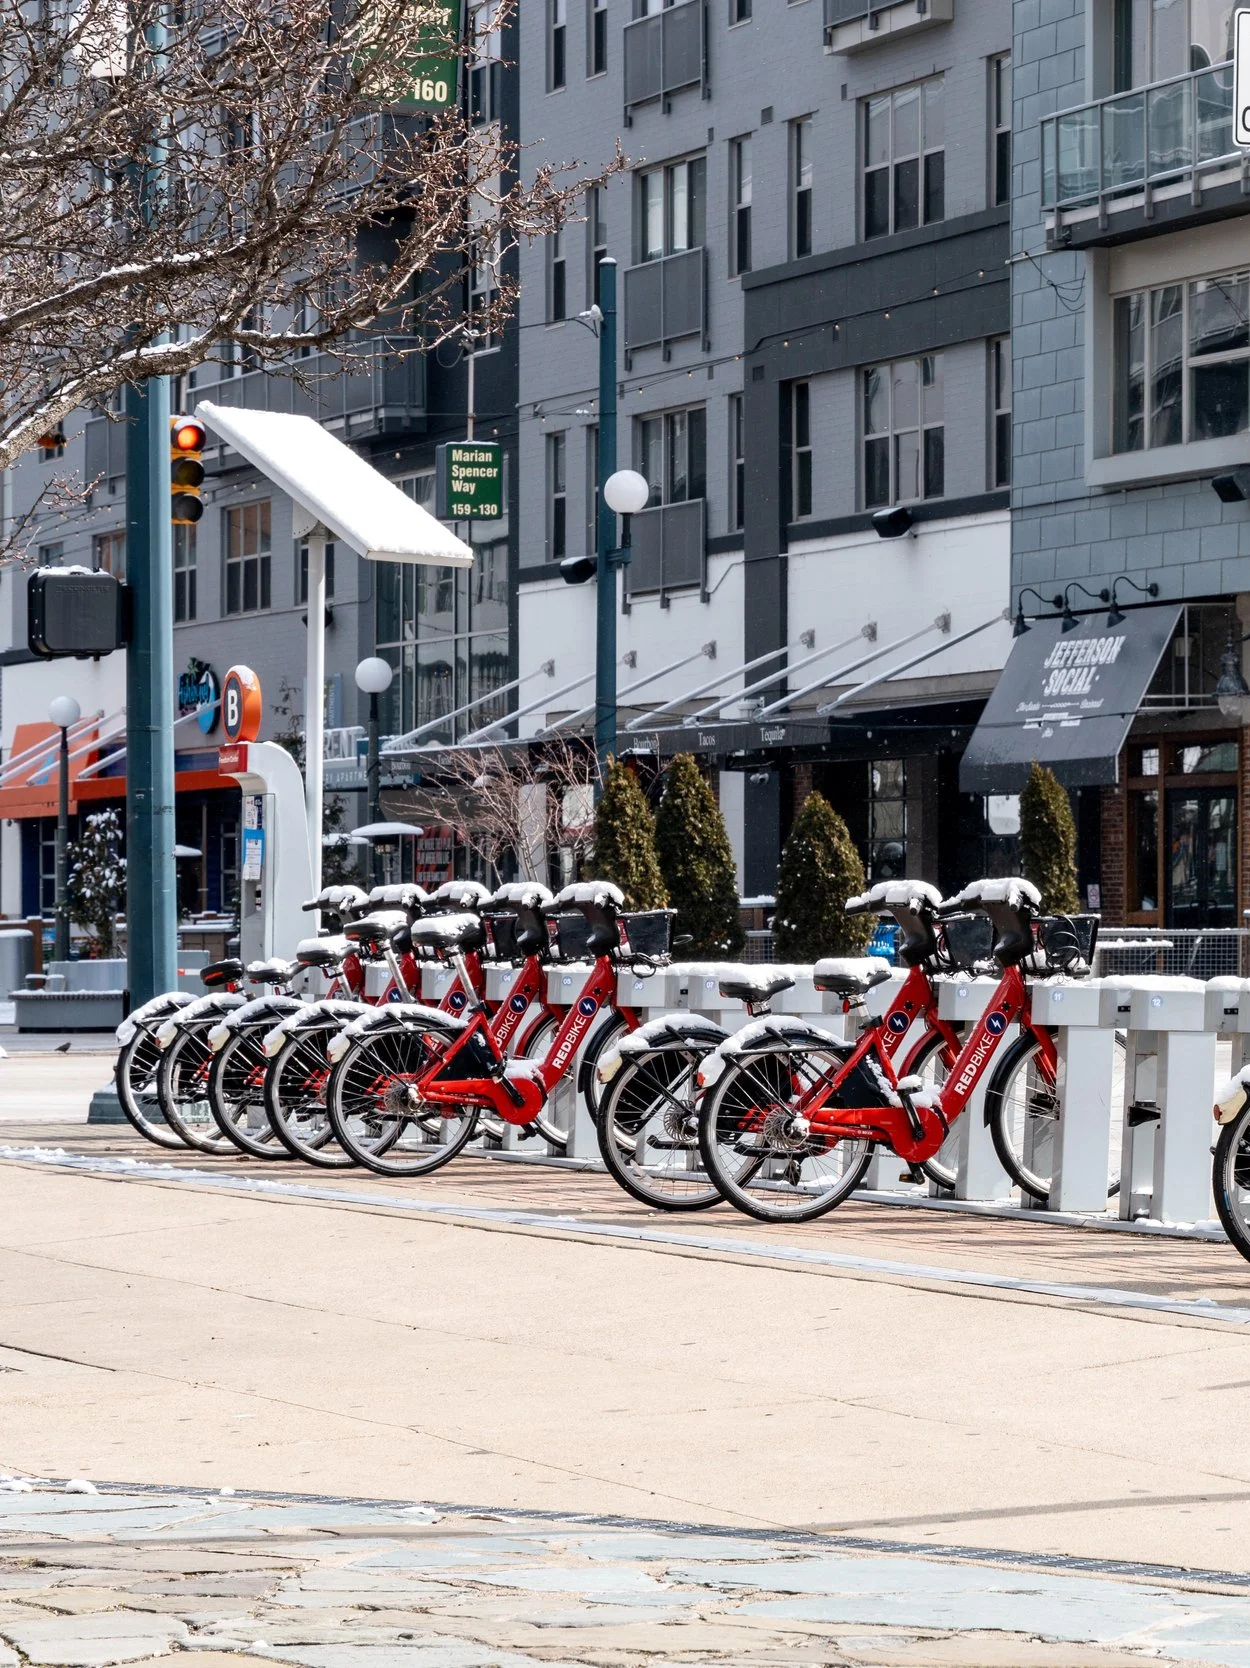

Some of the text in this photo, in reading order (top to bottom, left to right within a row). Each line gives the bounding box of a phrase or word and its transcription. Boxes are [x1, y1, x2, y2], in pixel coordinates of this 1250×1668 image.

[451, 449, 493, 462] Marian
[451, 464, 498, 479] Spencer
[451, 480, 476, 495] Way
[1044, 635, 1126, 669] JEFFERSON
[1043, 666, 1097, 697] SOCIAL
[227, 689, 239, 727] B
[698, 733, 715, 746] Tacos
[337, 770, 368, 782] APARTME
[959, 989, 967, 997] 10
[1054, 993, 1062, 1001] 11
[1152, 998, 1161, 1007] 12
[494, 1011, 518, 1048] DBIKE
[552, 1014, 587, 1070] REDBIKE
[954, 1033, 995, 1095] REDBIKE
